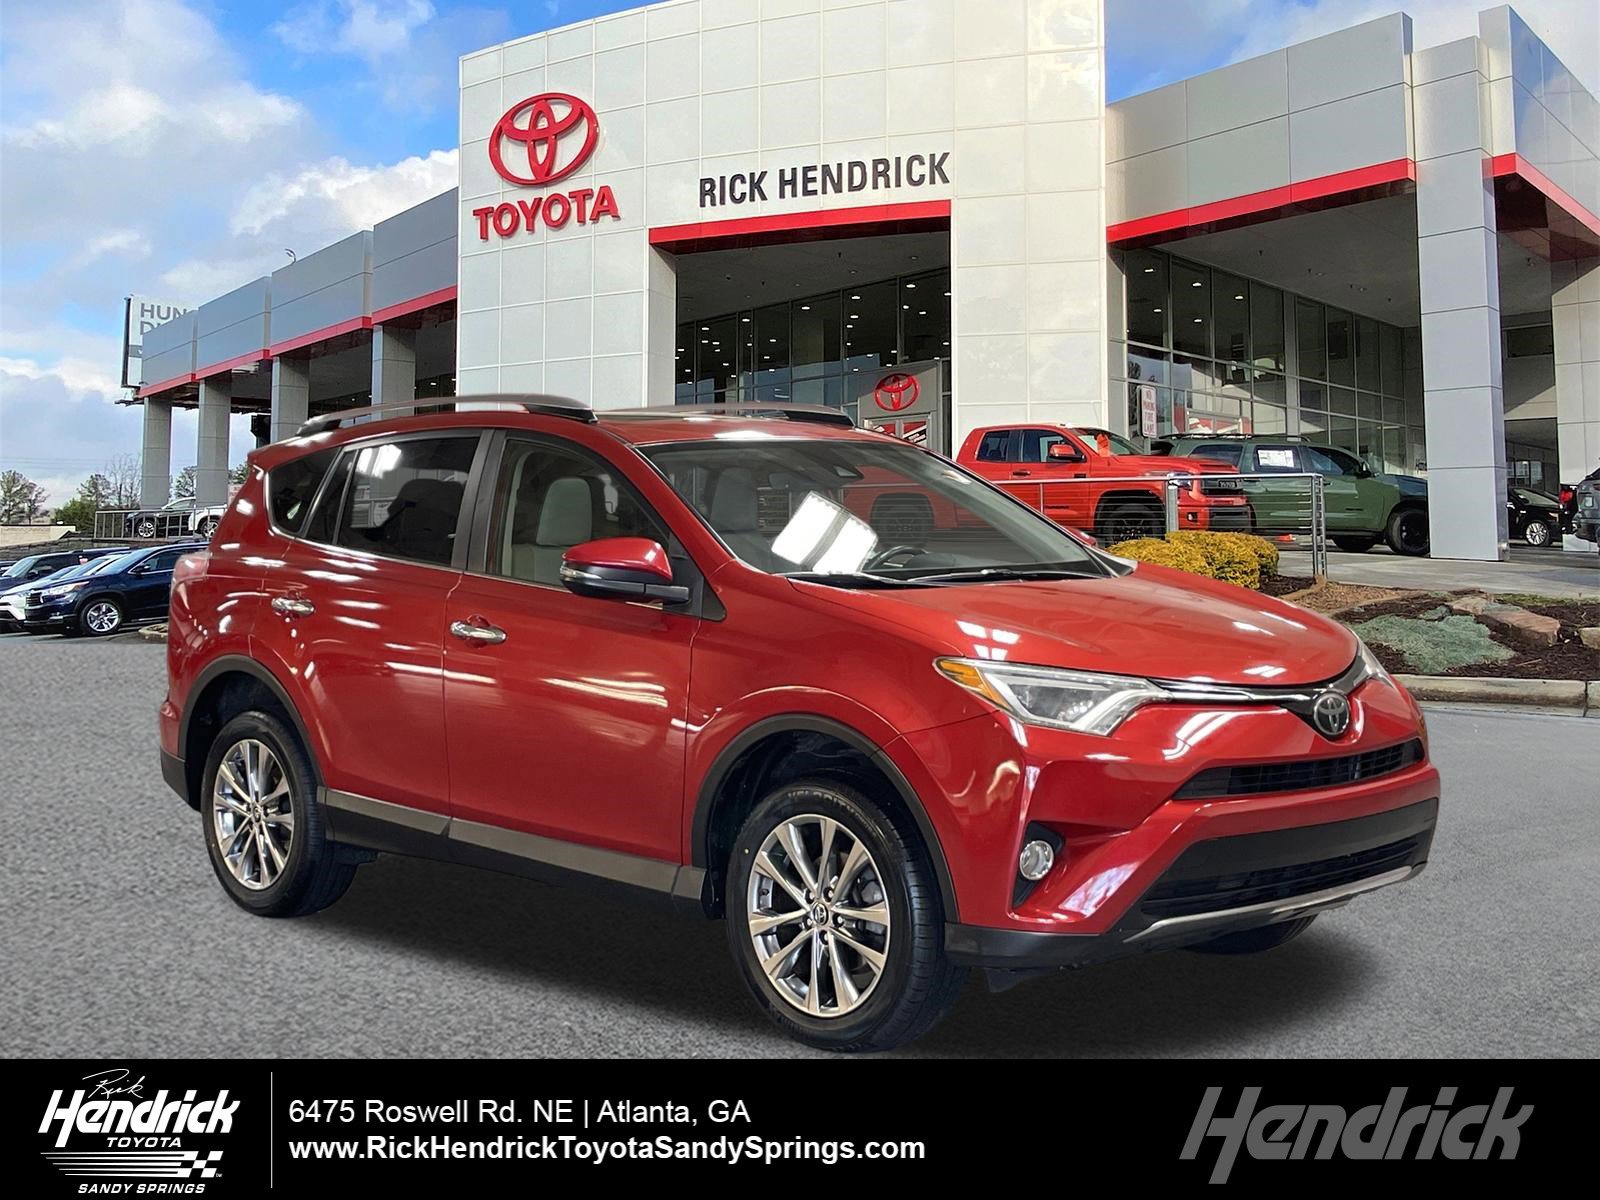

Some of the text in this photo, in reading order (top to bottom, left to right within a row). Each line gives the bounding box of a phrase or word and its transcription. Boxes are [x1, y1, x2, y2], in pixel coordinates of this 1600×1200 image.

[699, 152, 951, 208] RICK HENDRICK
[473, 185, 620, 240] TOYOTA
